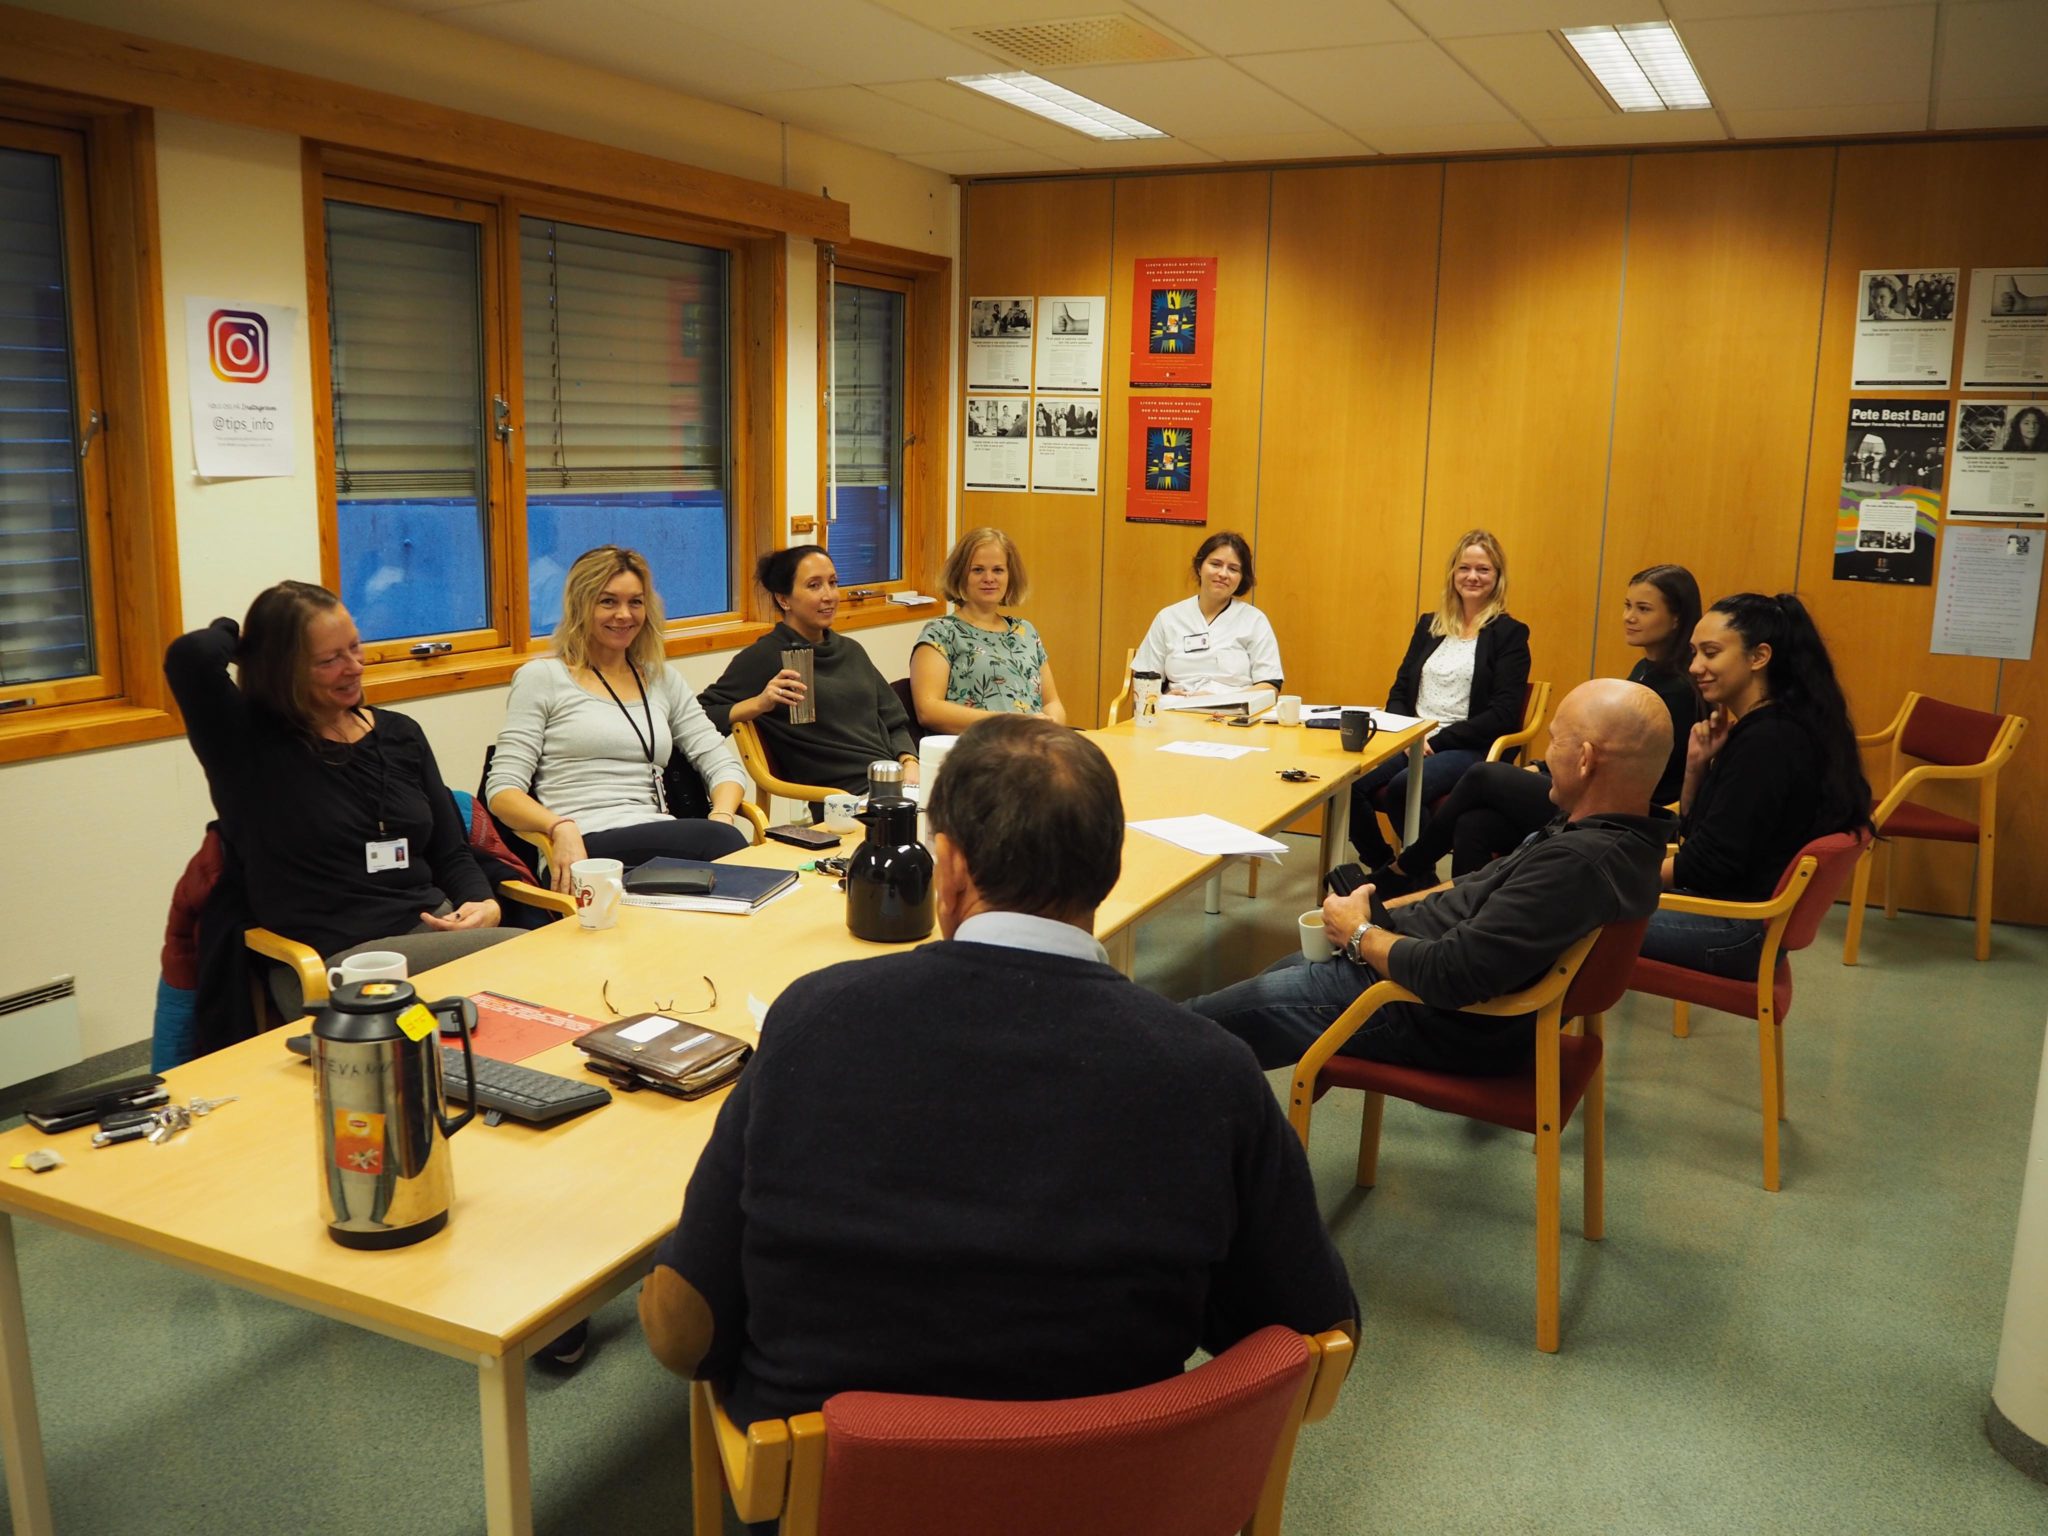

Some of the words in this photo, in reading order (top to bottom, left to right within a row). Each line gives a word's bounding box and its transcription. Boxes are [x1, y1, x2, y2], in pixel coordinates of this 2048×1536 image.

[1852, 408, 1880, 420] Pete
[1882, 409, 1910, 421] Best
[1912, 410, 1946, 422] Band
[213, 416, 274, 432] @tips_info
